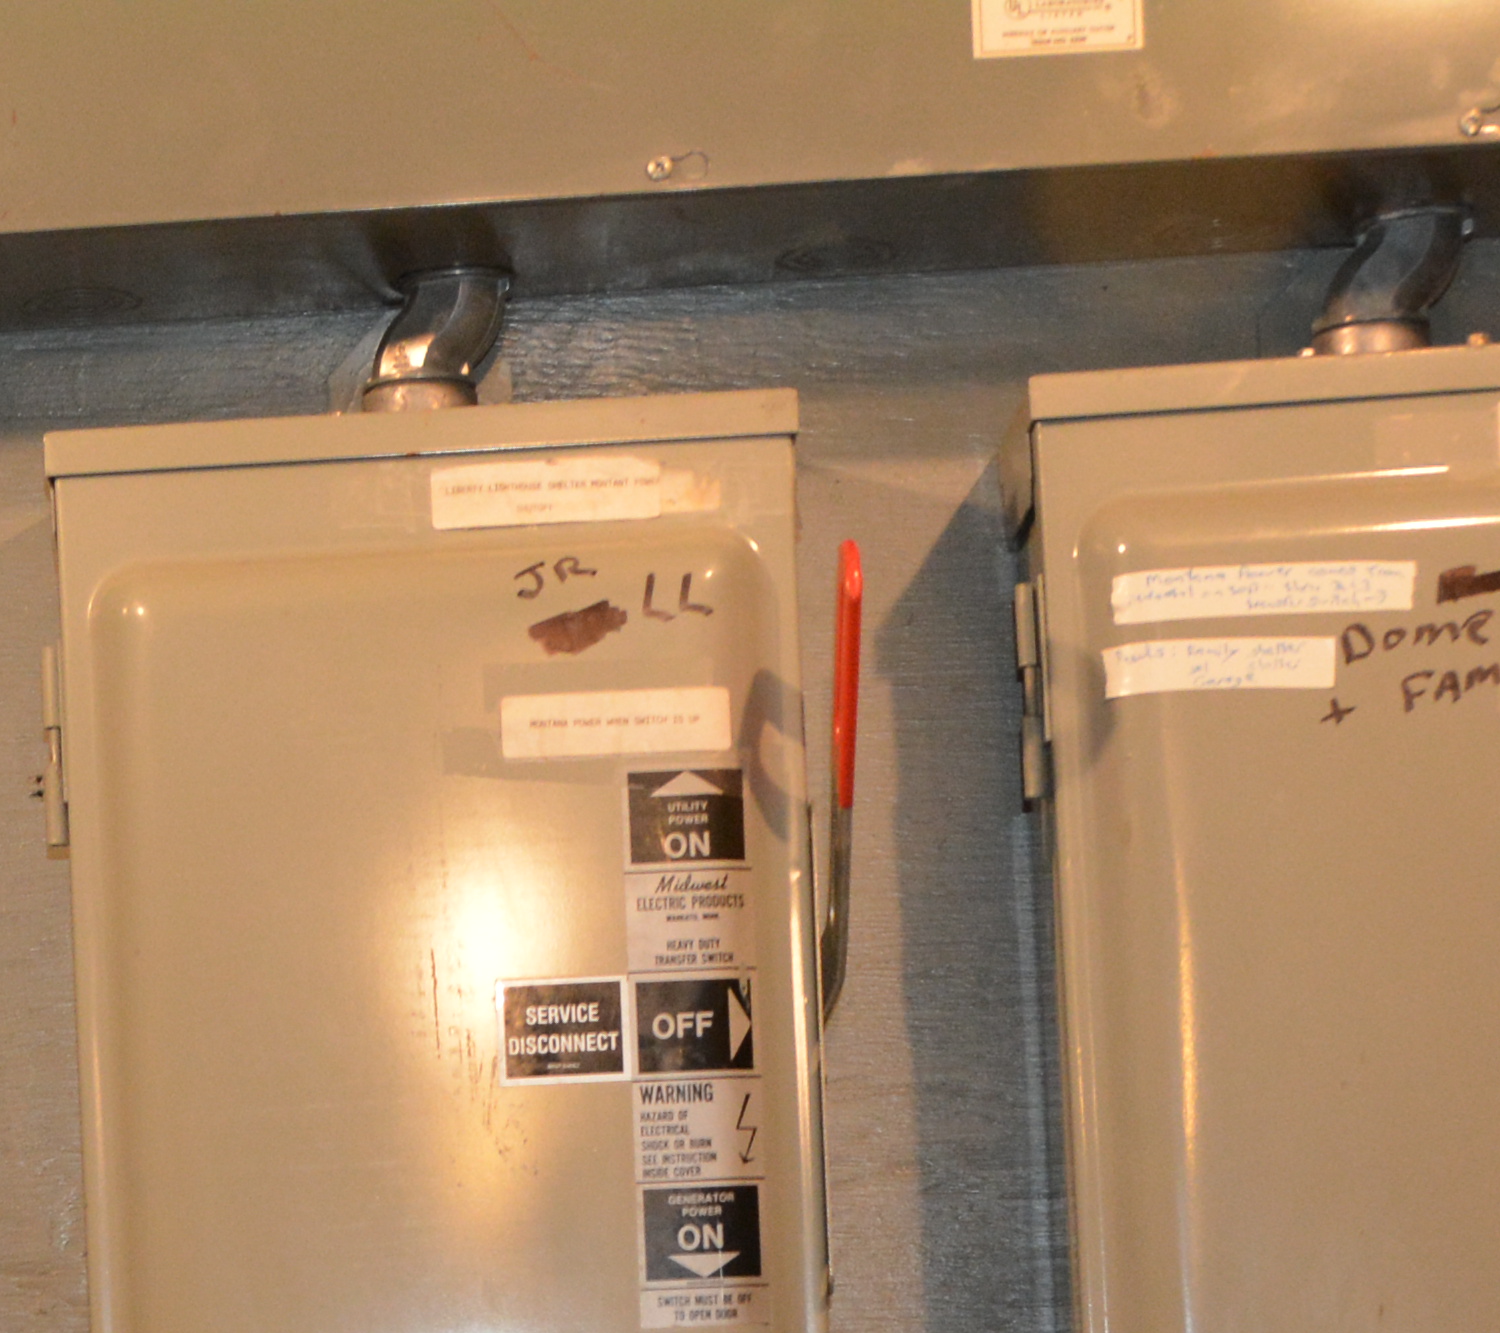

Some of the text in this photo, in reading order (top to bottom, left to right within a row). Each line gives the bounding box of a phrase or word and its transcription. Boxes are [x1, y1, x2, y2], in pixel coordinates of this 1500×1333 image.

[667, 801, 708, 813] UTILITY
[668, 812, 708, 825] POWER
[664, 830, 710, 859] ON
[655, 874, 729, 894] Midwest
[636, 893, 745, 911] ELECTRIC PRODUCTS
[666, 938, 720, 951] HEAVY DUTY
[655, 952, 734, 965] TRANSFER SWITCH
[525, 1001, 600, 1026] SERVICE
[652, 1010, 714, 1040] OFF
[508, 1030, 619, 1056] DISCONNECT
[640, 1083, 714, 1105] WARNING
[640, 1110, 688, 1122] HAZARD OF
[640, 1125, 690, 1137] ELECTRICAL
[641, 1138, 712, 1151] SHOCK OR BURN
[642, 1154, 657, 1165] SEE
[643, 1166, 702, 1178] INSIDE COVER
[668, 1191, 735, 1206] GENERATOR
[682, 1206, 722, 1218] POWER
[677, 1223, 724, 1251] ON
[657, 1295, 693, 1309] SWITCH
[689, 1309, 712, 1321] OPEN
[715, 1308, 738, 1320] DOOR
